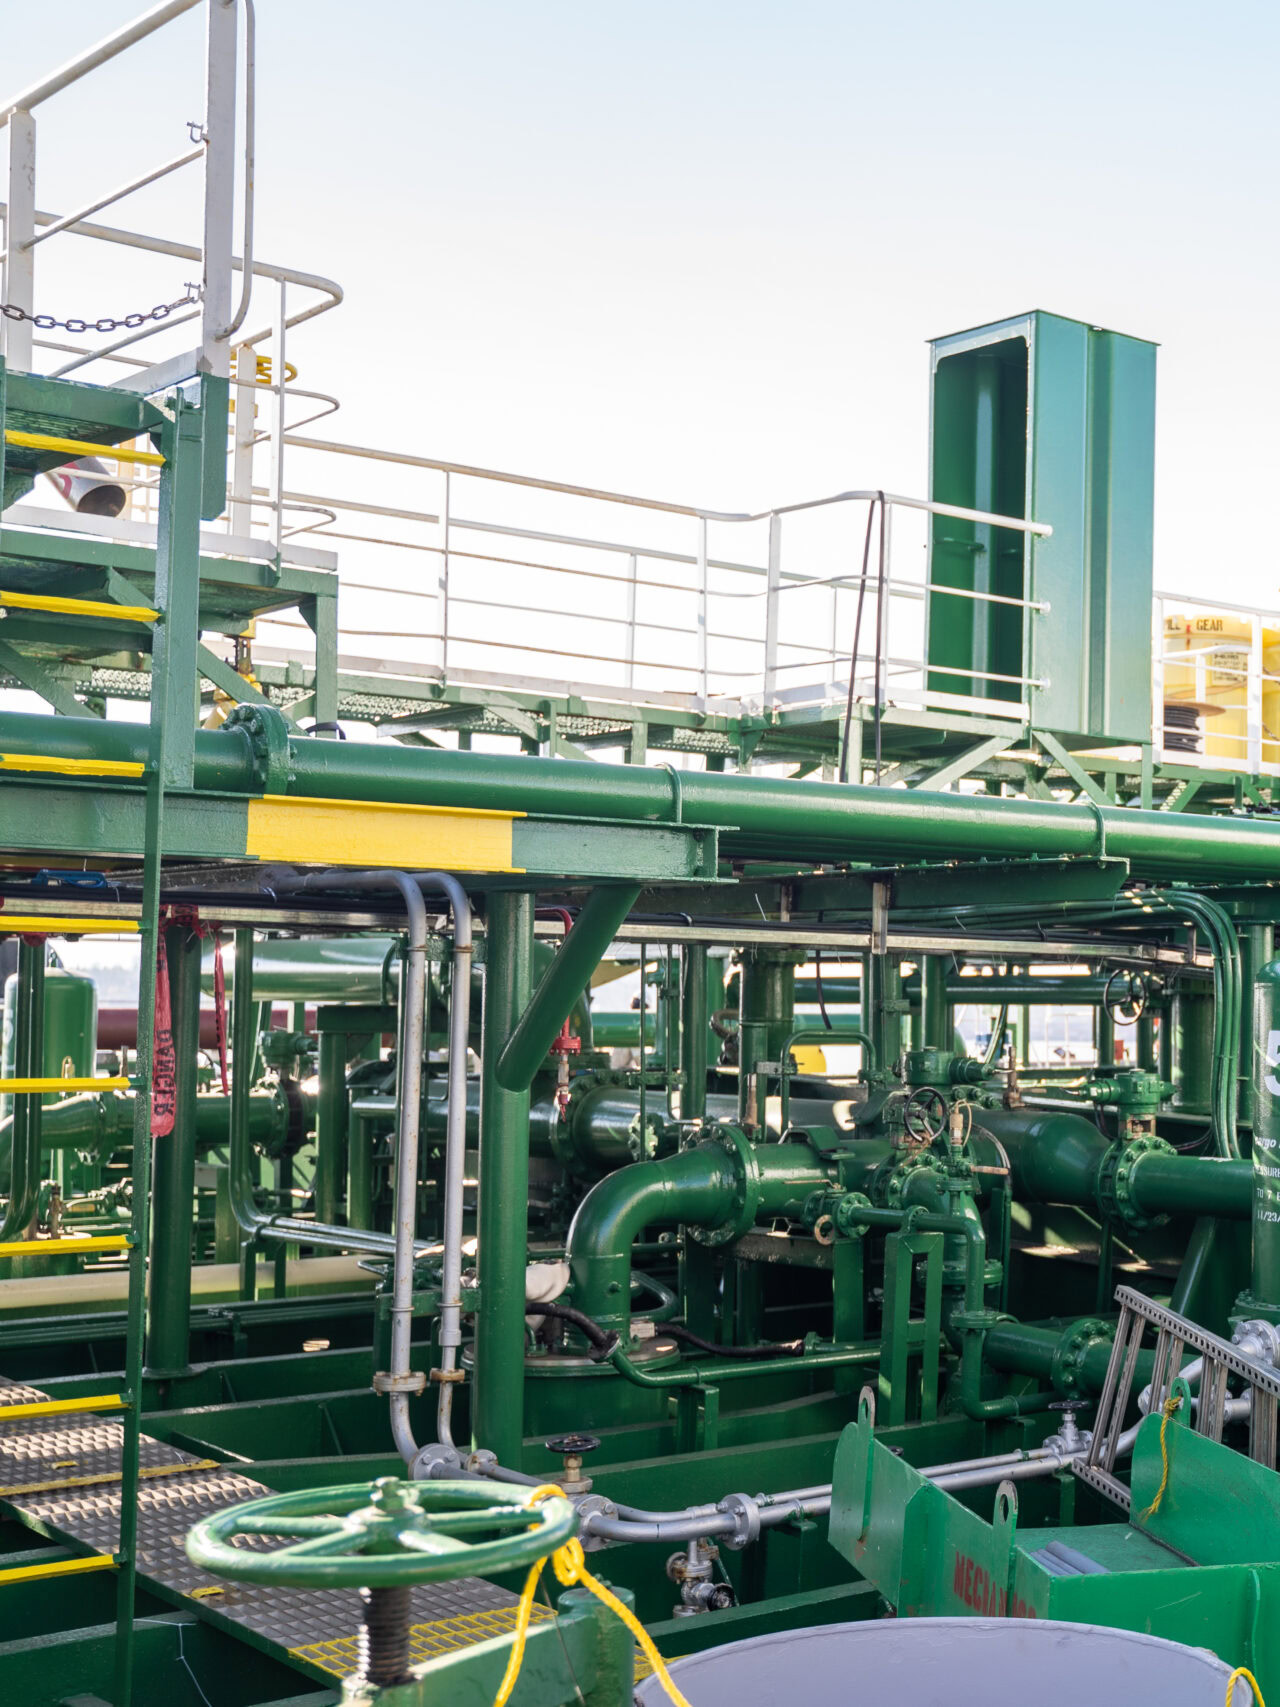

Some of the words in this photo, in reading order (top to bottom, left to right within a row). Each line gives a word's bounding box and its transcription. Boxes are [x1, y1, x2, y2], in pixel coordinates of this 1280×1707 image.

[1196, 619, 1224, 632] GEAR
[153, 1028, 176, 1117] DANGER
[1266, 1189, 1273, 1200] 7
